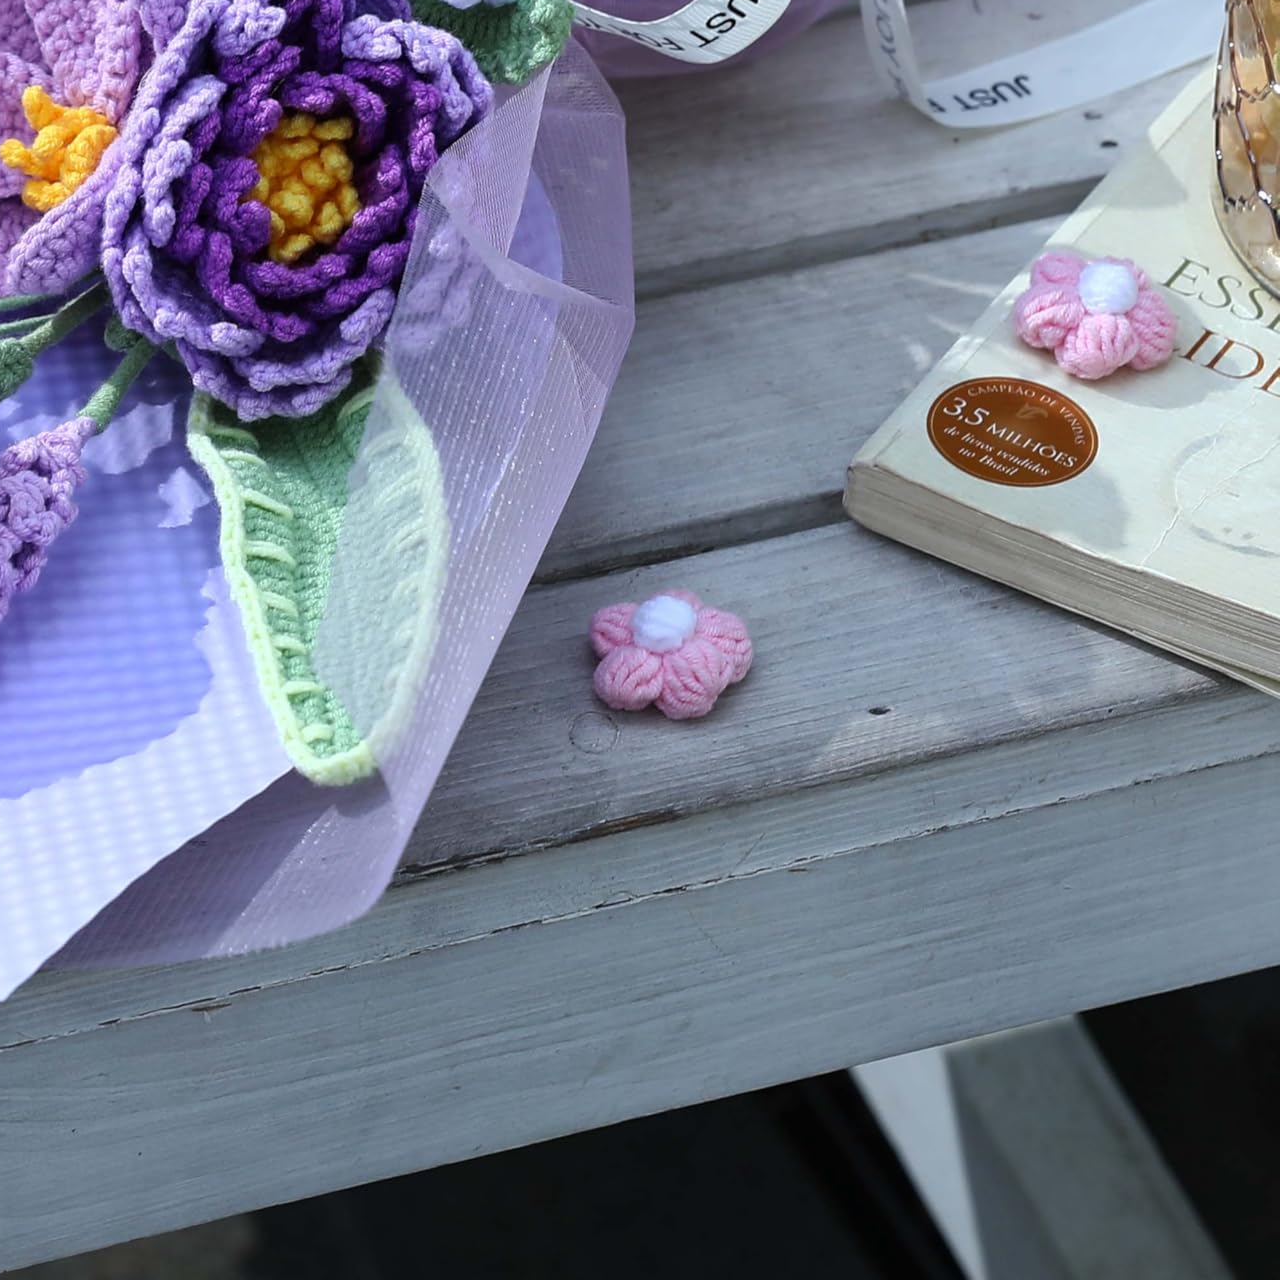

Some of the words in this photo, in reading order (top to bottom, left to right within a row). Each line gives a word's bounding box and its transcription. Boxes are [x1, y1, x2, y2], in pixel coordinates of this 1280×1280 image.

[952, 73, 1032, 111] JUST
[1159, 256, 1280, 334] ESS
[942, 396, 990, 426] 3,5
[943, 426, 960, 437] de
[961, 432, 994, 453] livros
[996, 448, 1051, 477] vendidos
[958, 447, 976, 458] no
[979, 454, 1019, 477] Brasil
